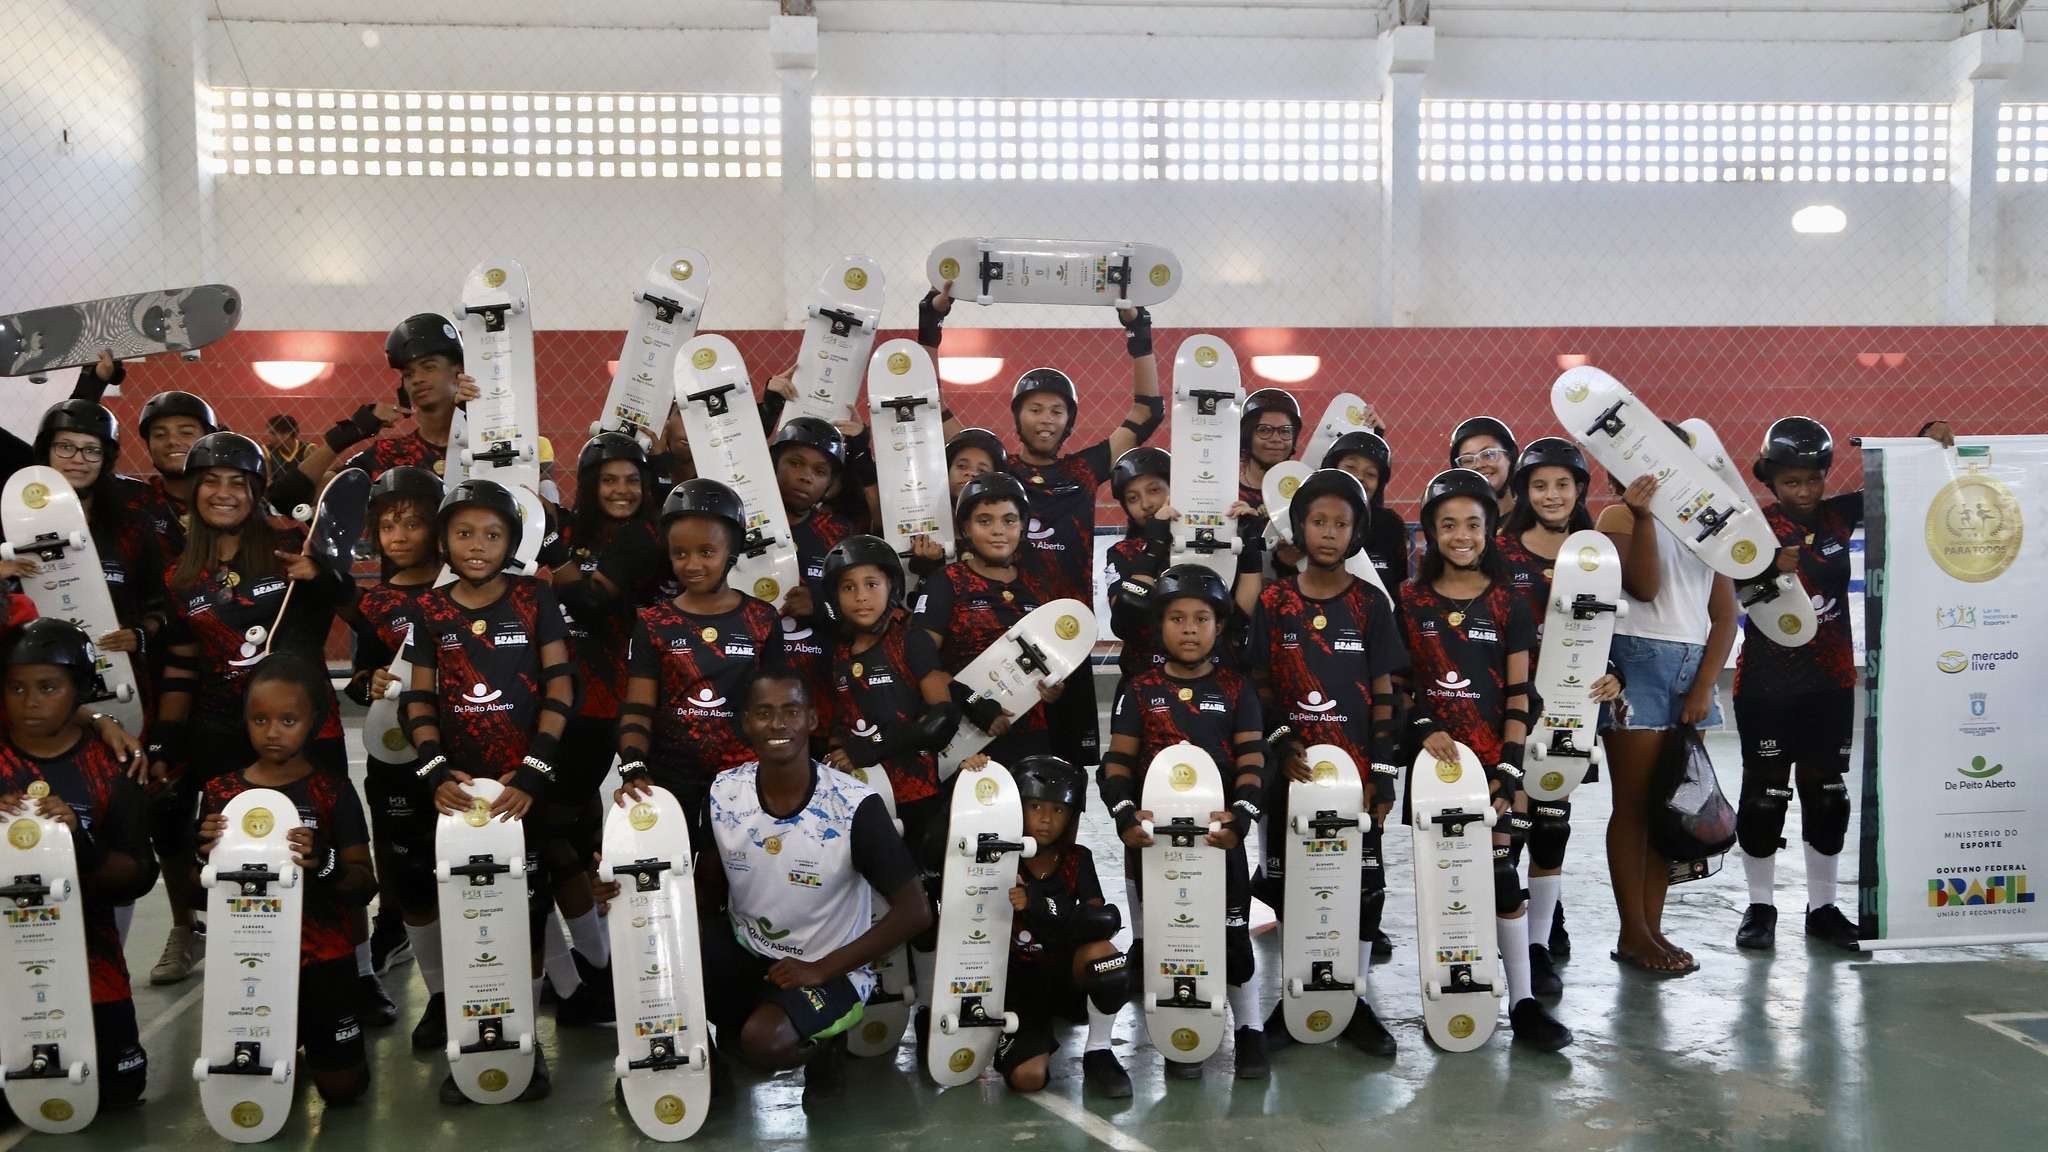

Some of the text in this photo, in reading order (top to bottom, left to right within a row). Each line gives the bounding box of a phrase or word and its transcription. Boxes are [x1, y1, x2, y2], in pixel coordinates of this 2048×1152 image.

[1944, 544, 2008, 555] PARA TODOS
[1972, 651, 2020, 661] mercado
[1972, 662, 1996, 671] livre
[486, 703, 514, 712] Aberto
[1320, 713, 1348, 722] Aberto
[1945, 780, 2016, 790] De Peito Aberto
[1537, 806, 1566, 817] HARDY
[2005, 828, 2018, 837] DO
[1960, 841, 2002, 849] ESPORTE
[1936, 864, 2027, 874] GOVERNO FEDERAL
[1928, 875, 2035, 907] BRASIL
[771, 942, 804, 956] Aberto
[1094, 955, 1127, 972] HARDY
